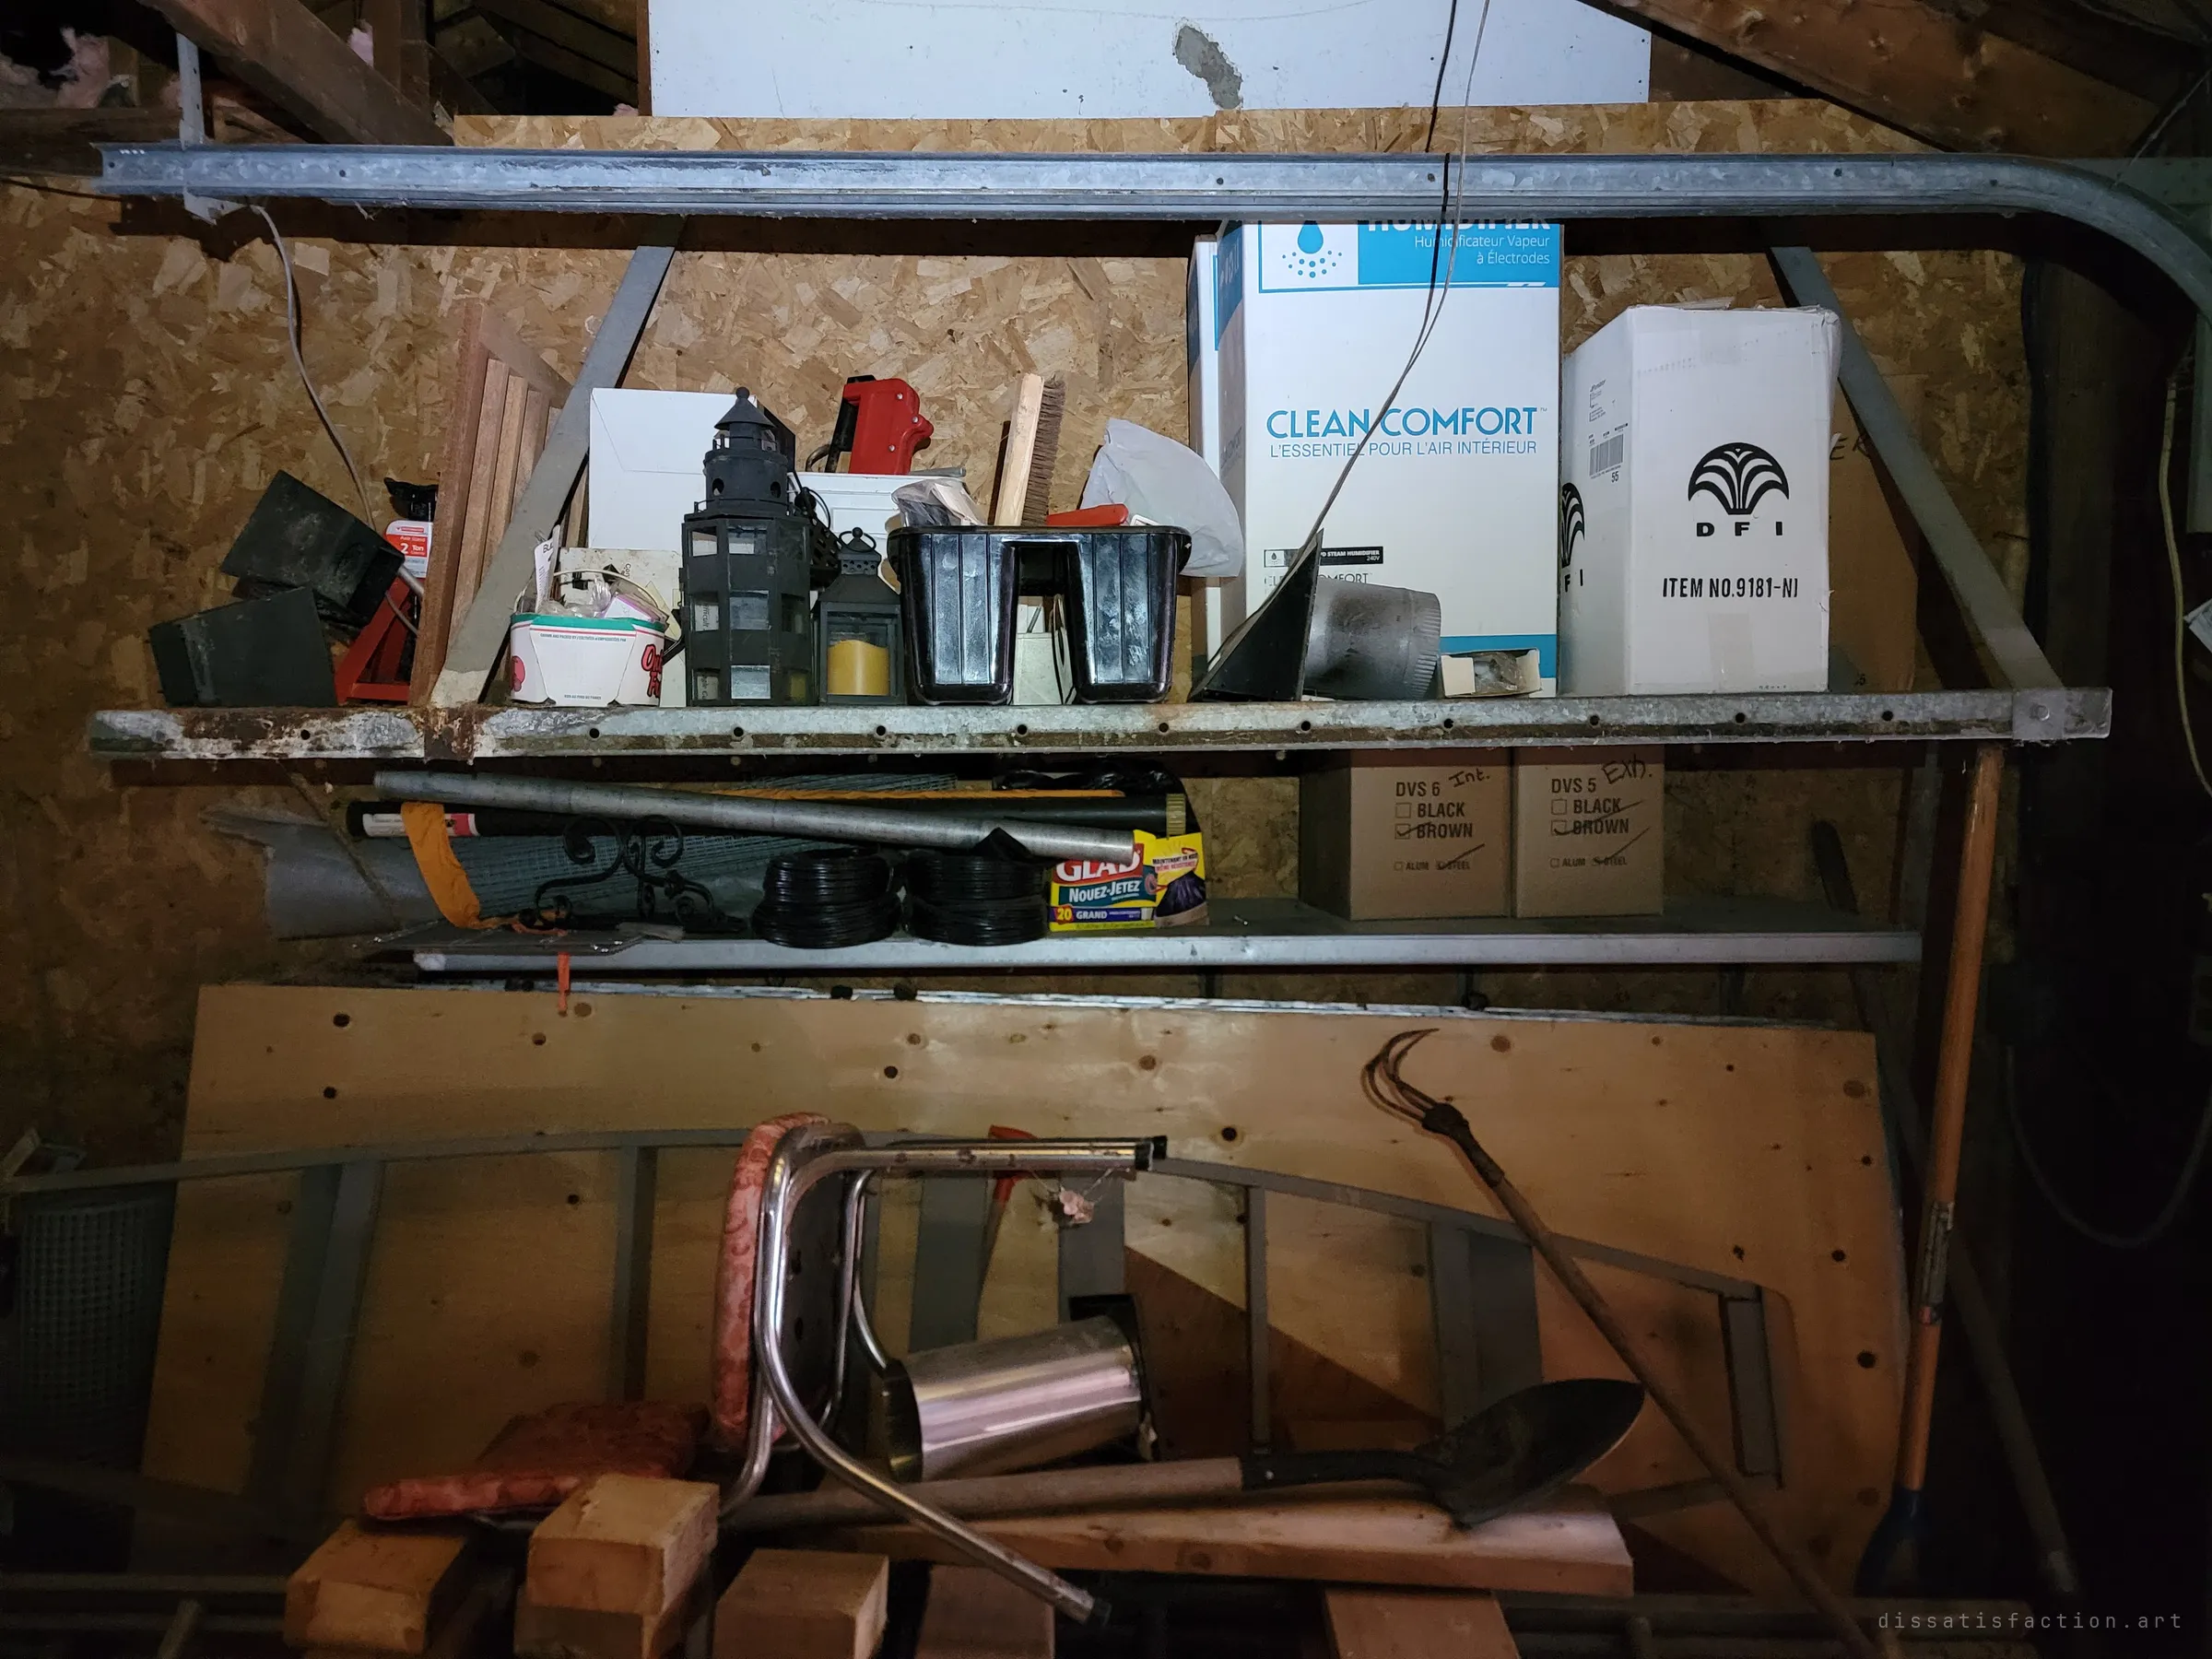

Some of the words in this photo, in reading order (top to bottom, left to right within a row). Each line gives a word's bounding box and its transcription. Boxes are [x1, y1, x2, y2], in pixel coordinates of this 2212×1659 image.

[1507, 235, 1549, 250] Vapeur
[1477, 253, 1484, 265] à
[1488, 250, 1550, 265] Électrodes
[1266, 408, 1370, 440] CLEAN
[1381, 406, 1537, 437] COMFORT
[1369, 441, 1412, 455] POUR
[1417, 441, 1453, 455] L'AIR
[1458, 438, 1537, 454] INTÉRIEUR
[1611, 471, 1619, 483] 55
[400, 543, 409, 554] 2
[1663, 578, 1703, 598] ITEM
[1449, 768, 1490, 787] Int.
[1551, 778, 1583, 793] DVS
[1588, 778, 1596, 793] 5
[1395, 782, 1427, 797] DVS
[1431, 782, 1440, 796] 6
[1418, 802, 1465, 818] BLACK
[1573, 797, 1622, 814] BLACK
[1417, 822, 1473, 839] BROWN
[1573, 818, 1630, 835] BROWN
[1056, 852, 1140, 882] GLAD
[1057, 908, 1073, 921] 20
[1076, 911, 1108, 920] GRAND
